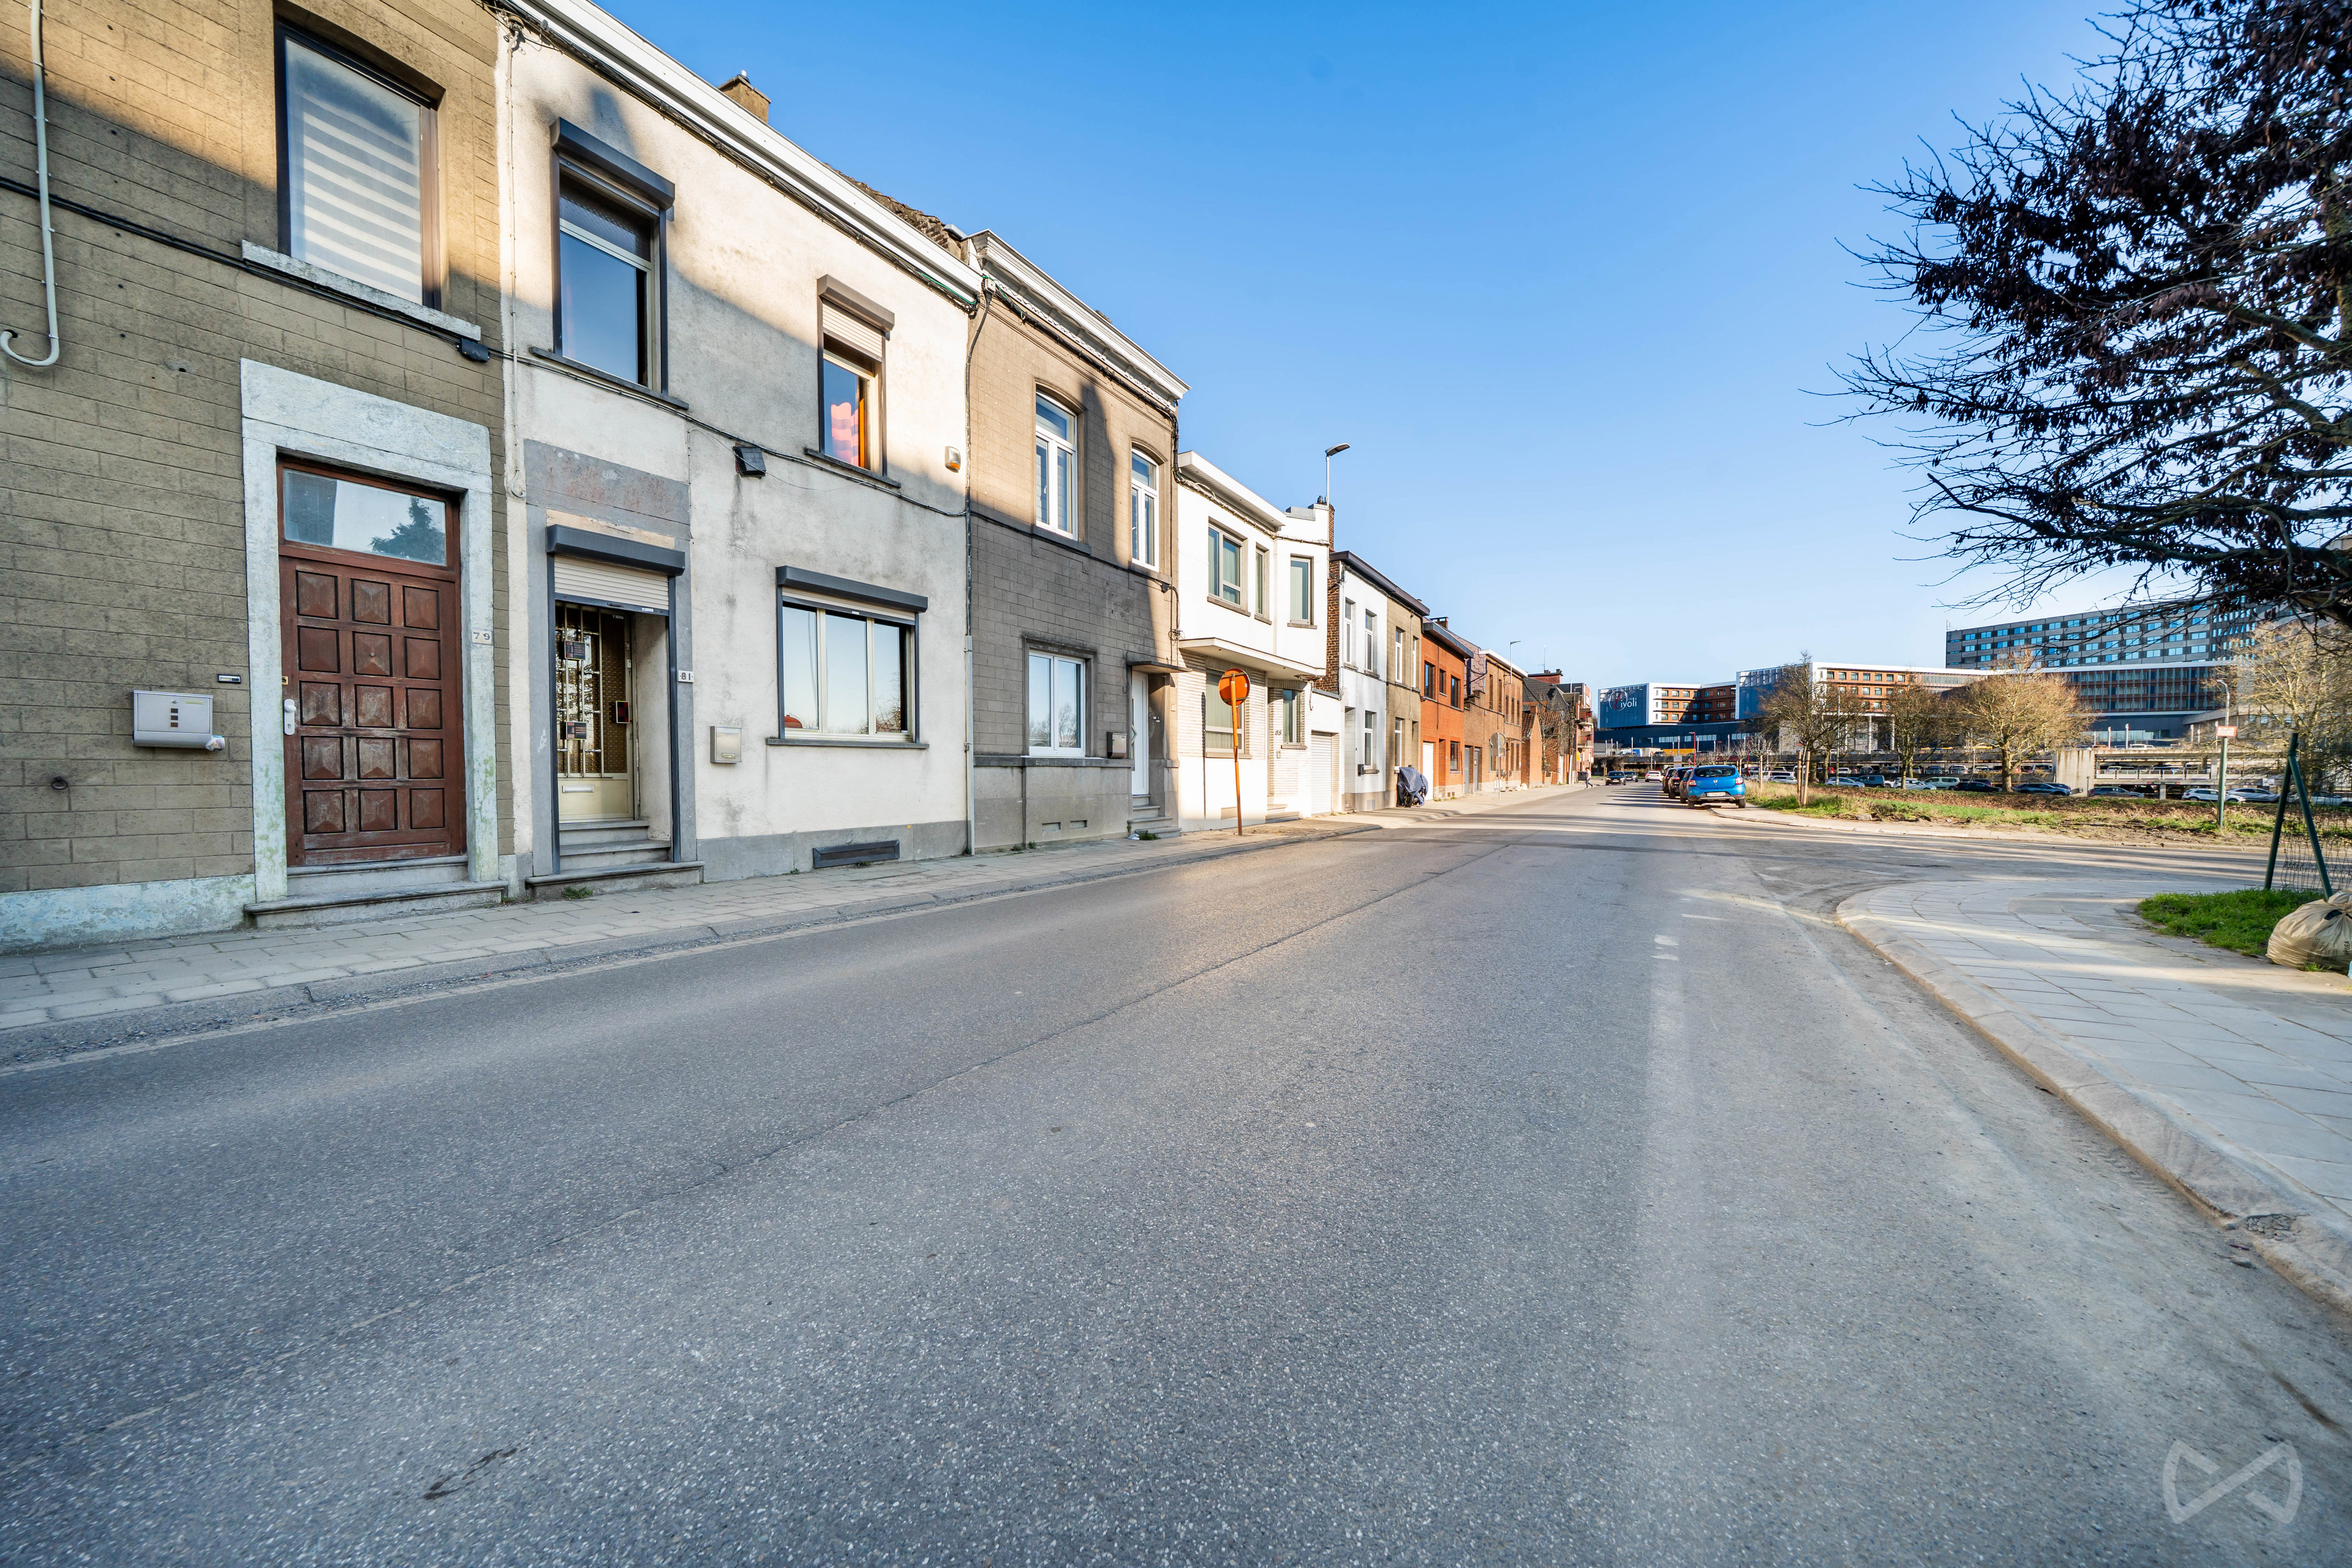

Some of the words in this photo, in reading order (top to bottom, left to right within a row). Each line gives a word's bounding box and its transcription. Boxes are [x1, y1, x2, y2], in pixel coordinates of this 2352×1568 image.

[473, 632, 490, 640] 79
[681, 672, 691, 680] 81
[1613, 691, 1637, 710] tivoli
